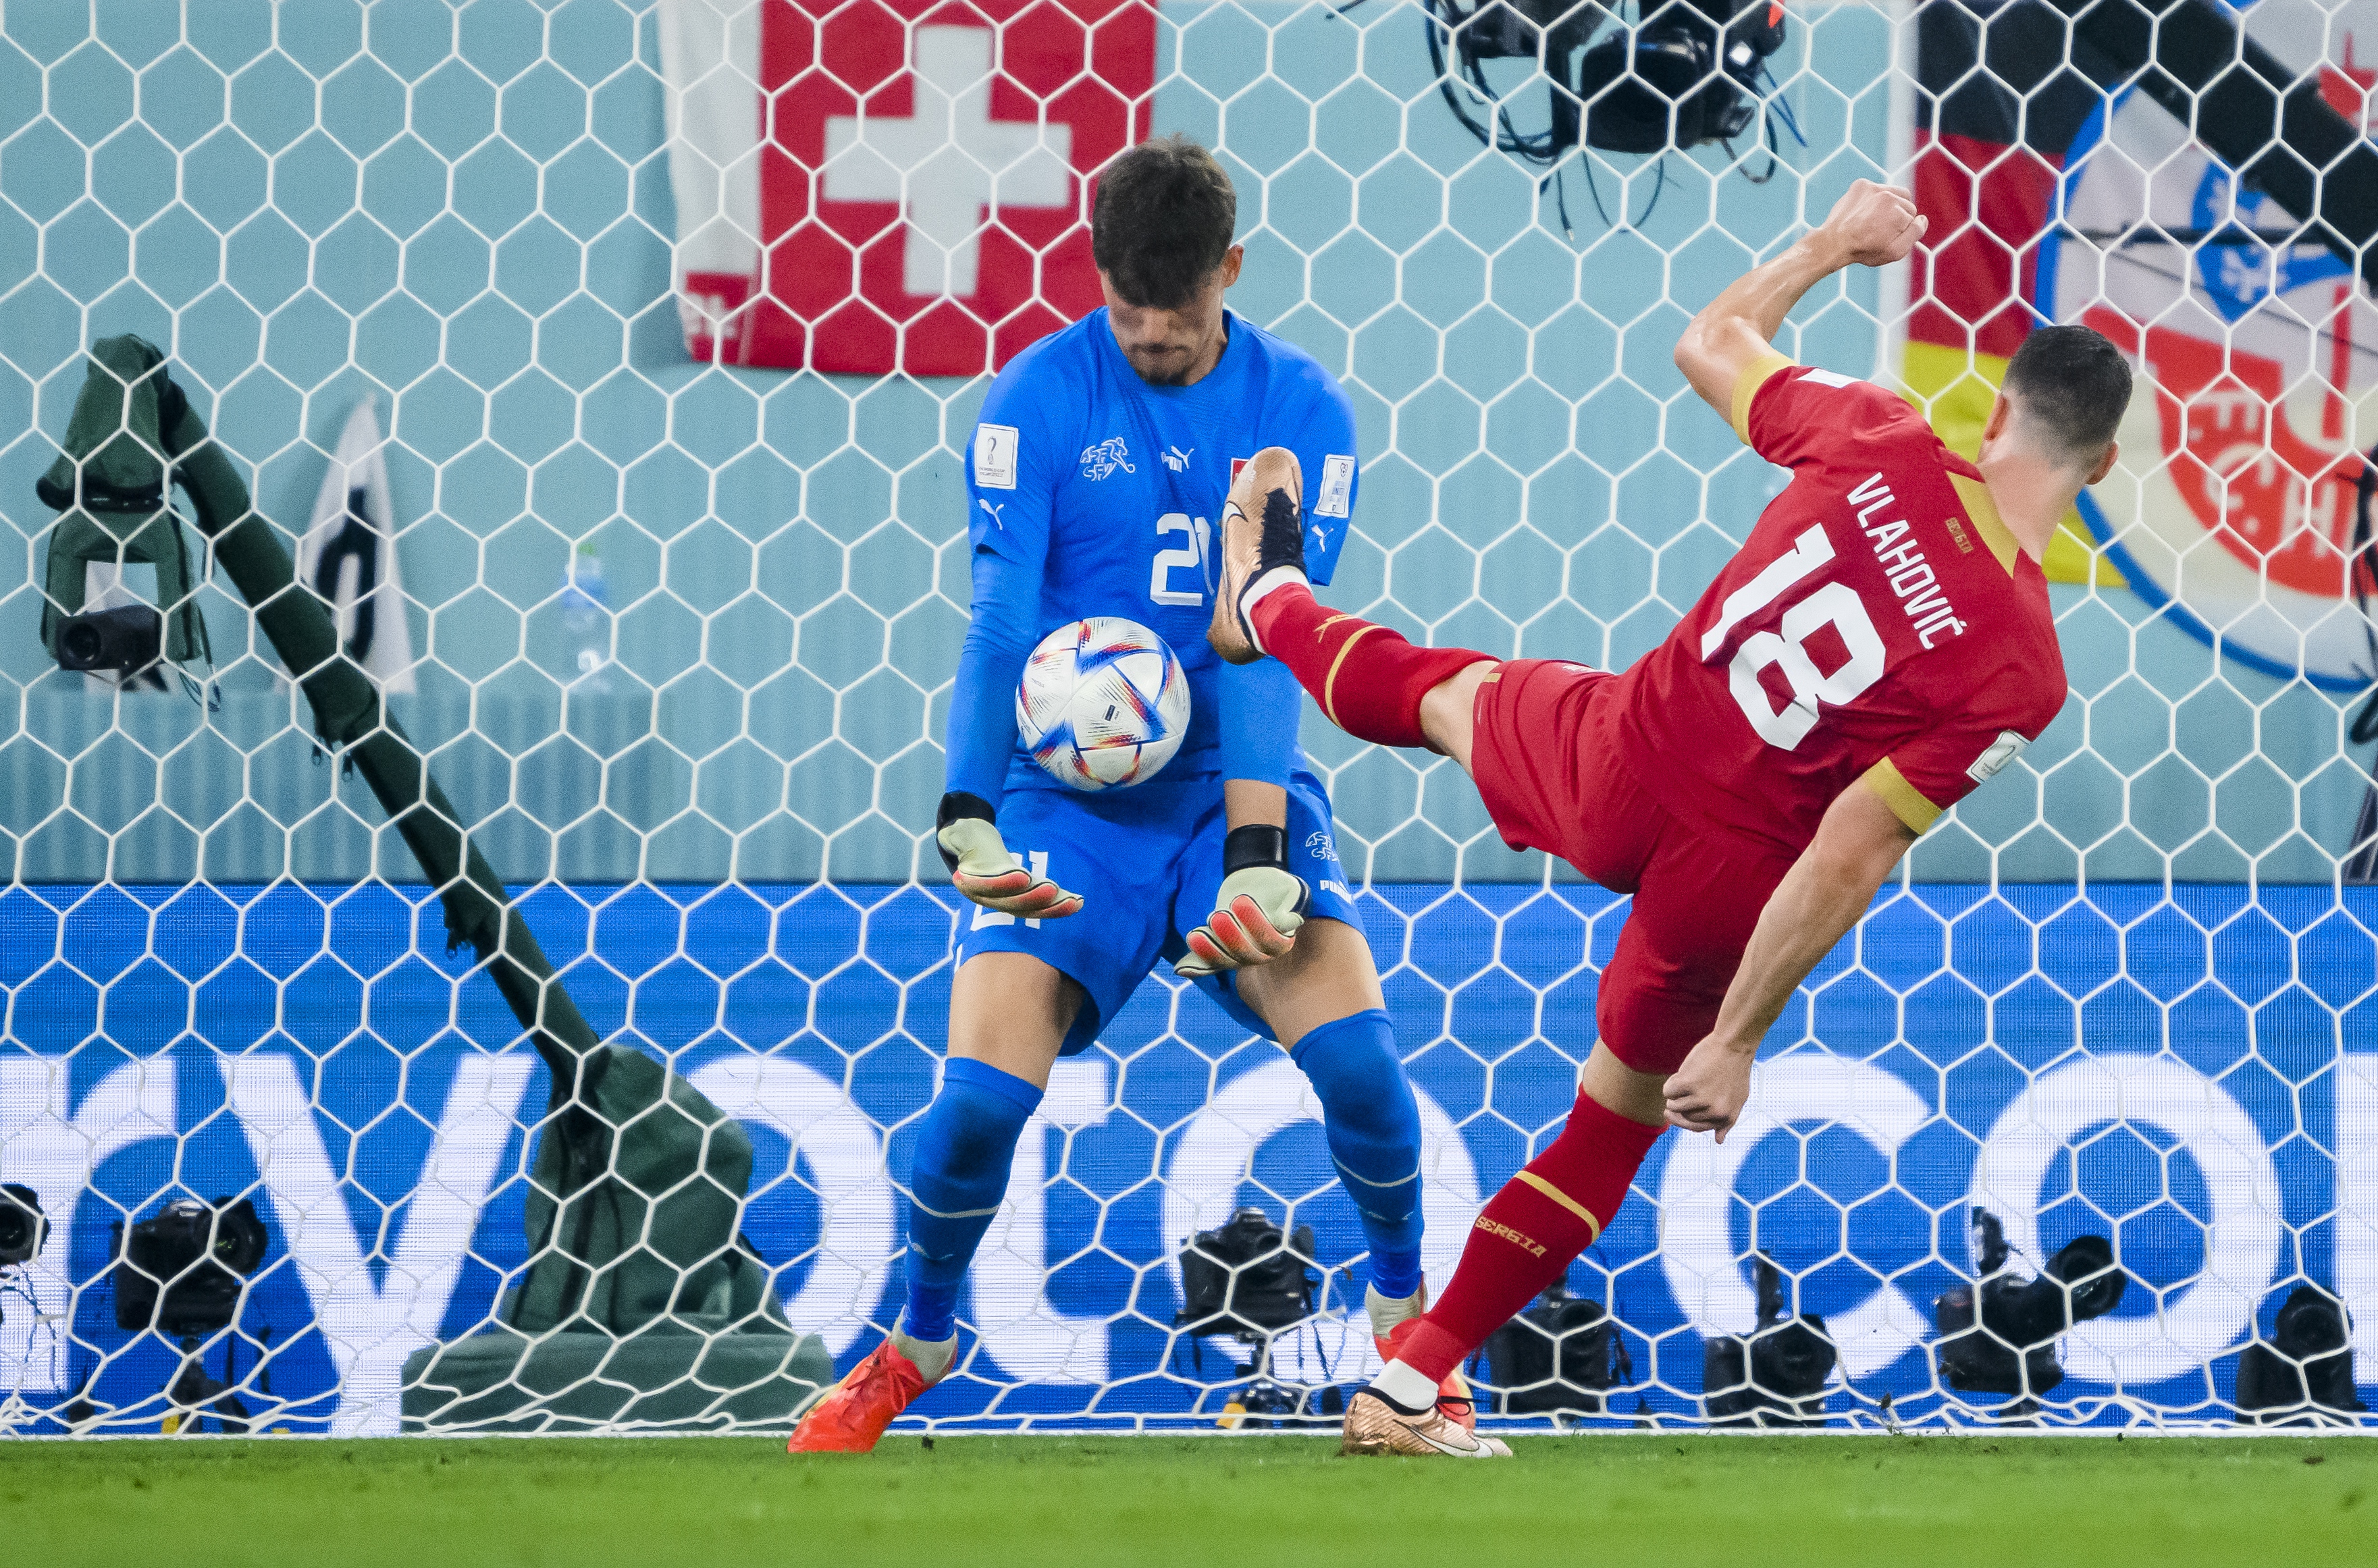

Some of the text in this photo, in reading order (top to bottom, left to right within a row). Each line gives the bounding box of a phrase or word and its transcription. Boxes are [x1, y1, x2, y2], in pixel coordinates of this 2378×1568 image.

[1151, 513, 1215, 606] 21
[1701, 522, 1886, 751] 18
[1847, 472, 1966, 649] VLAHOVIĆ
